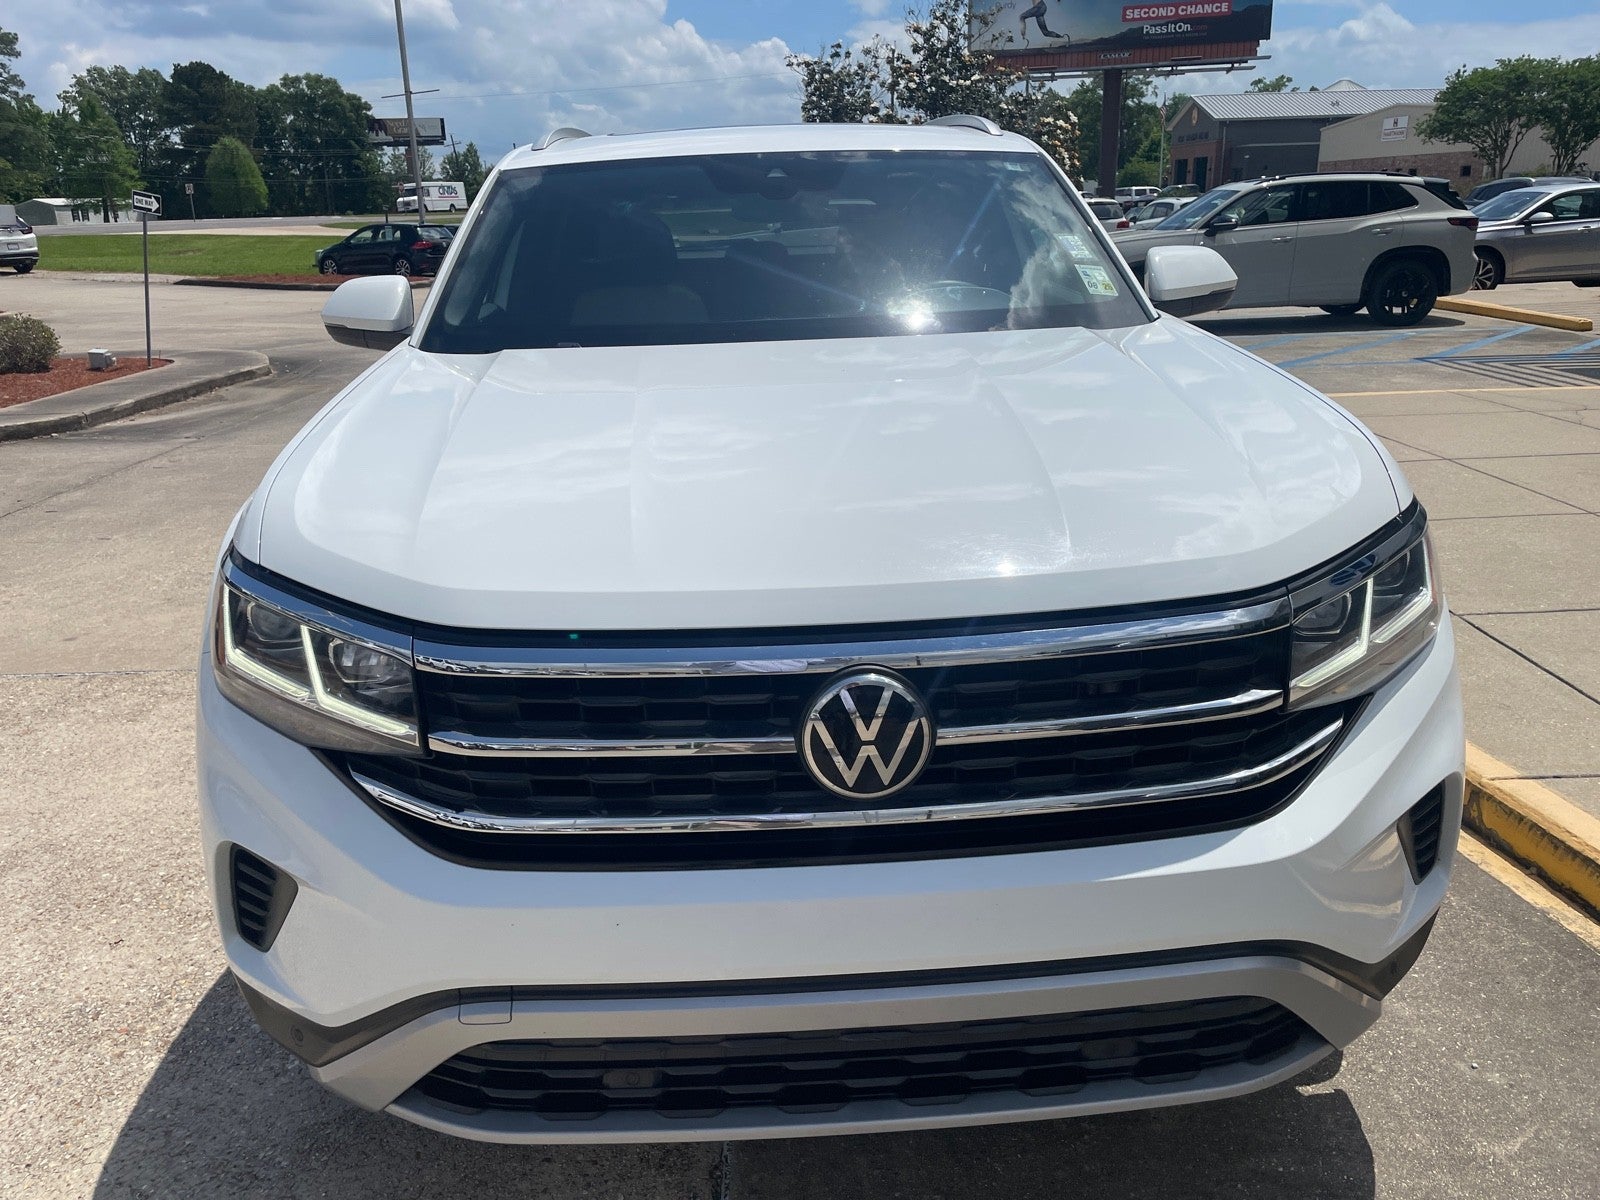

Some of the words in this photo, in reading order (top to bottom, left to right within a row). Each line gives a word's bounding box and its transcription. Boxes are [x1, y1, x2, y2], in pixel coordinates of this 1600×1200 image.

[1125, 7, 1175, 19] SECOND
[1178, 3, 1229, 15] CHANCE
[1143, 23, 1208, 35] PassItOn.com
[135, 197, 144, 205] ONE
[144, 199, 154, 207] WAY
[810, 687, 921, 788] VW
